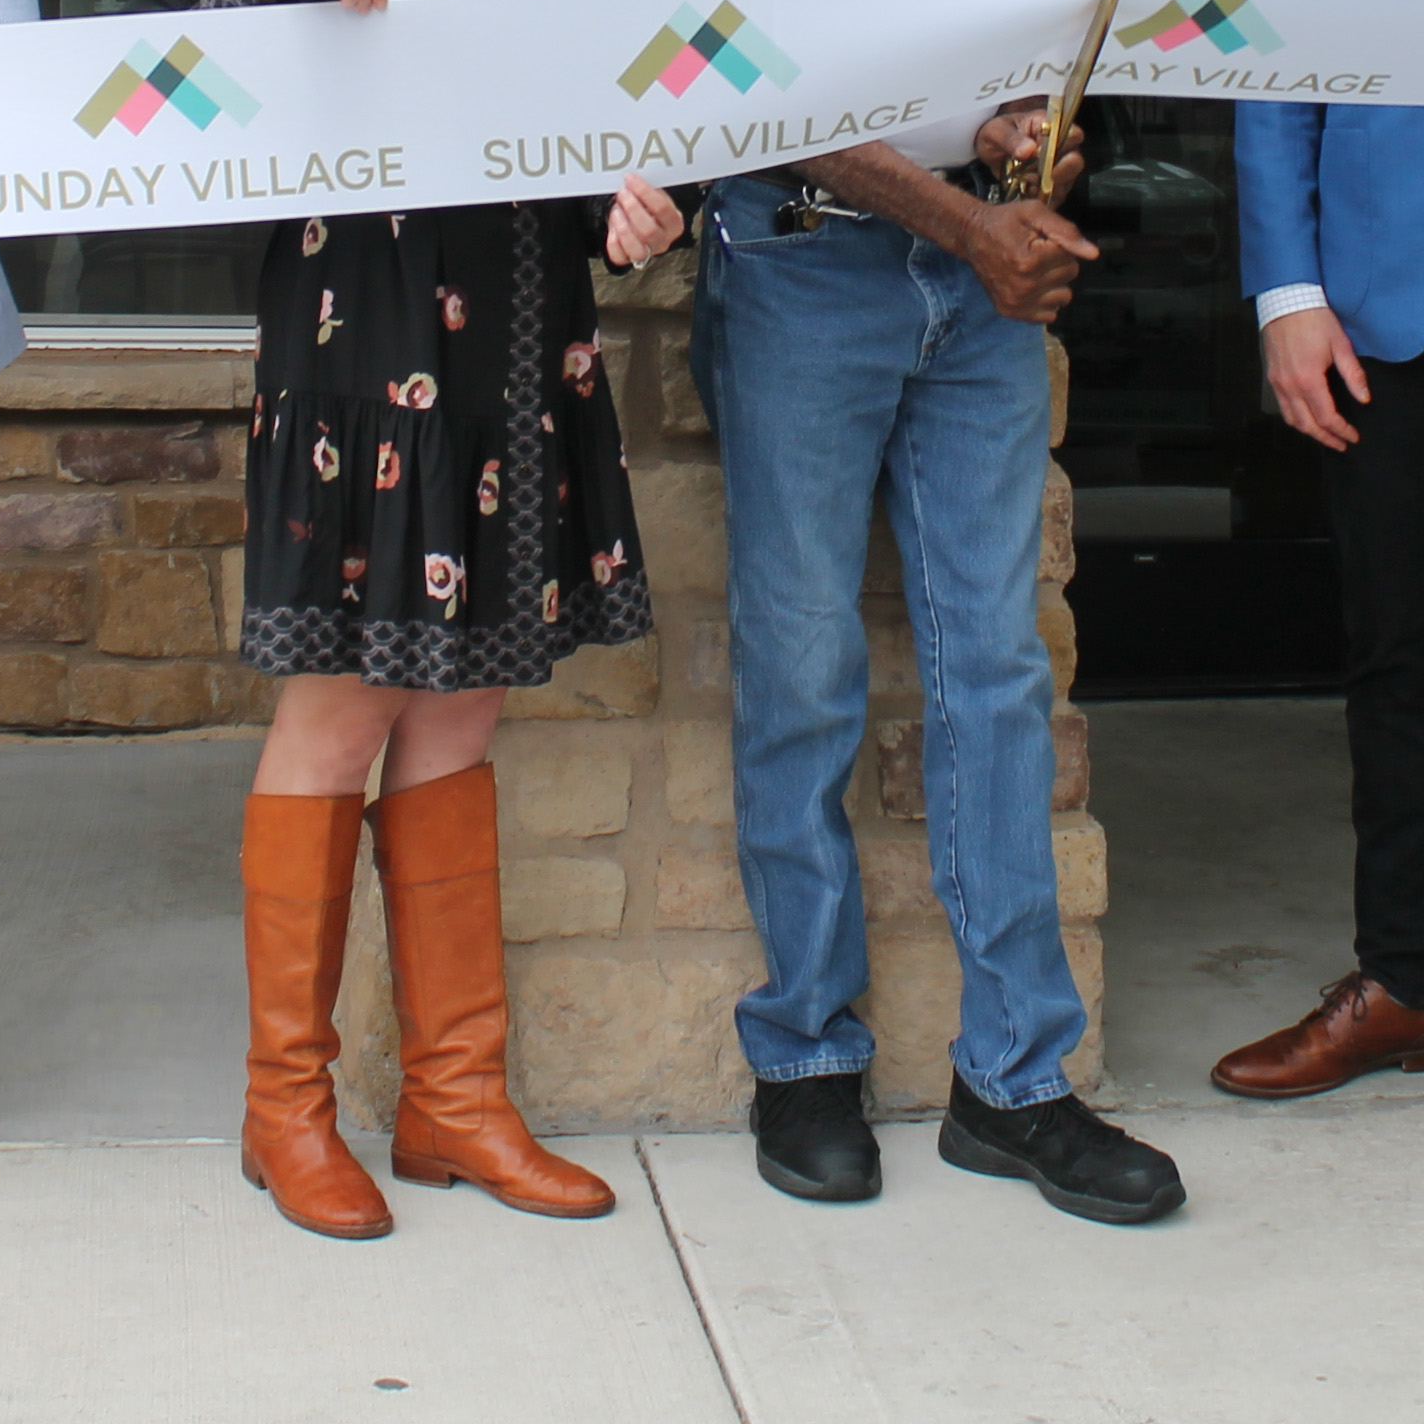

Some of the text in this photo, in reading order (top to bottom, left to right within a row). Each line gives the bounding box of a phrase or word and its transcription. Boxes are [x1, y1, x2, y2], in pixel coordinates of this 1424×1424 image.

[1191, 67, 1392, 96] VILLAGE
[482, 97, 929, 181] SUNDAY VILLAGE
[181, 146, 407, 202] VILLAGE
